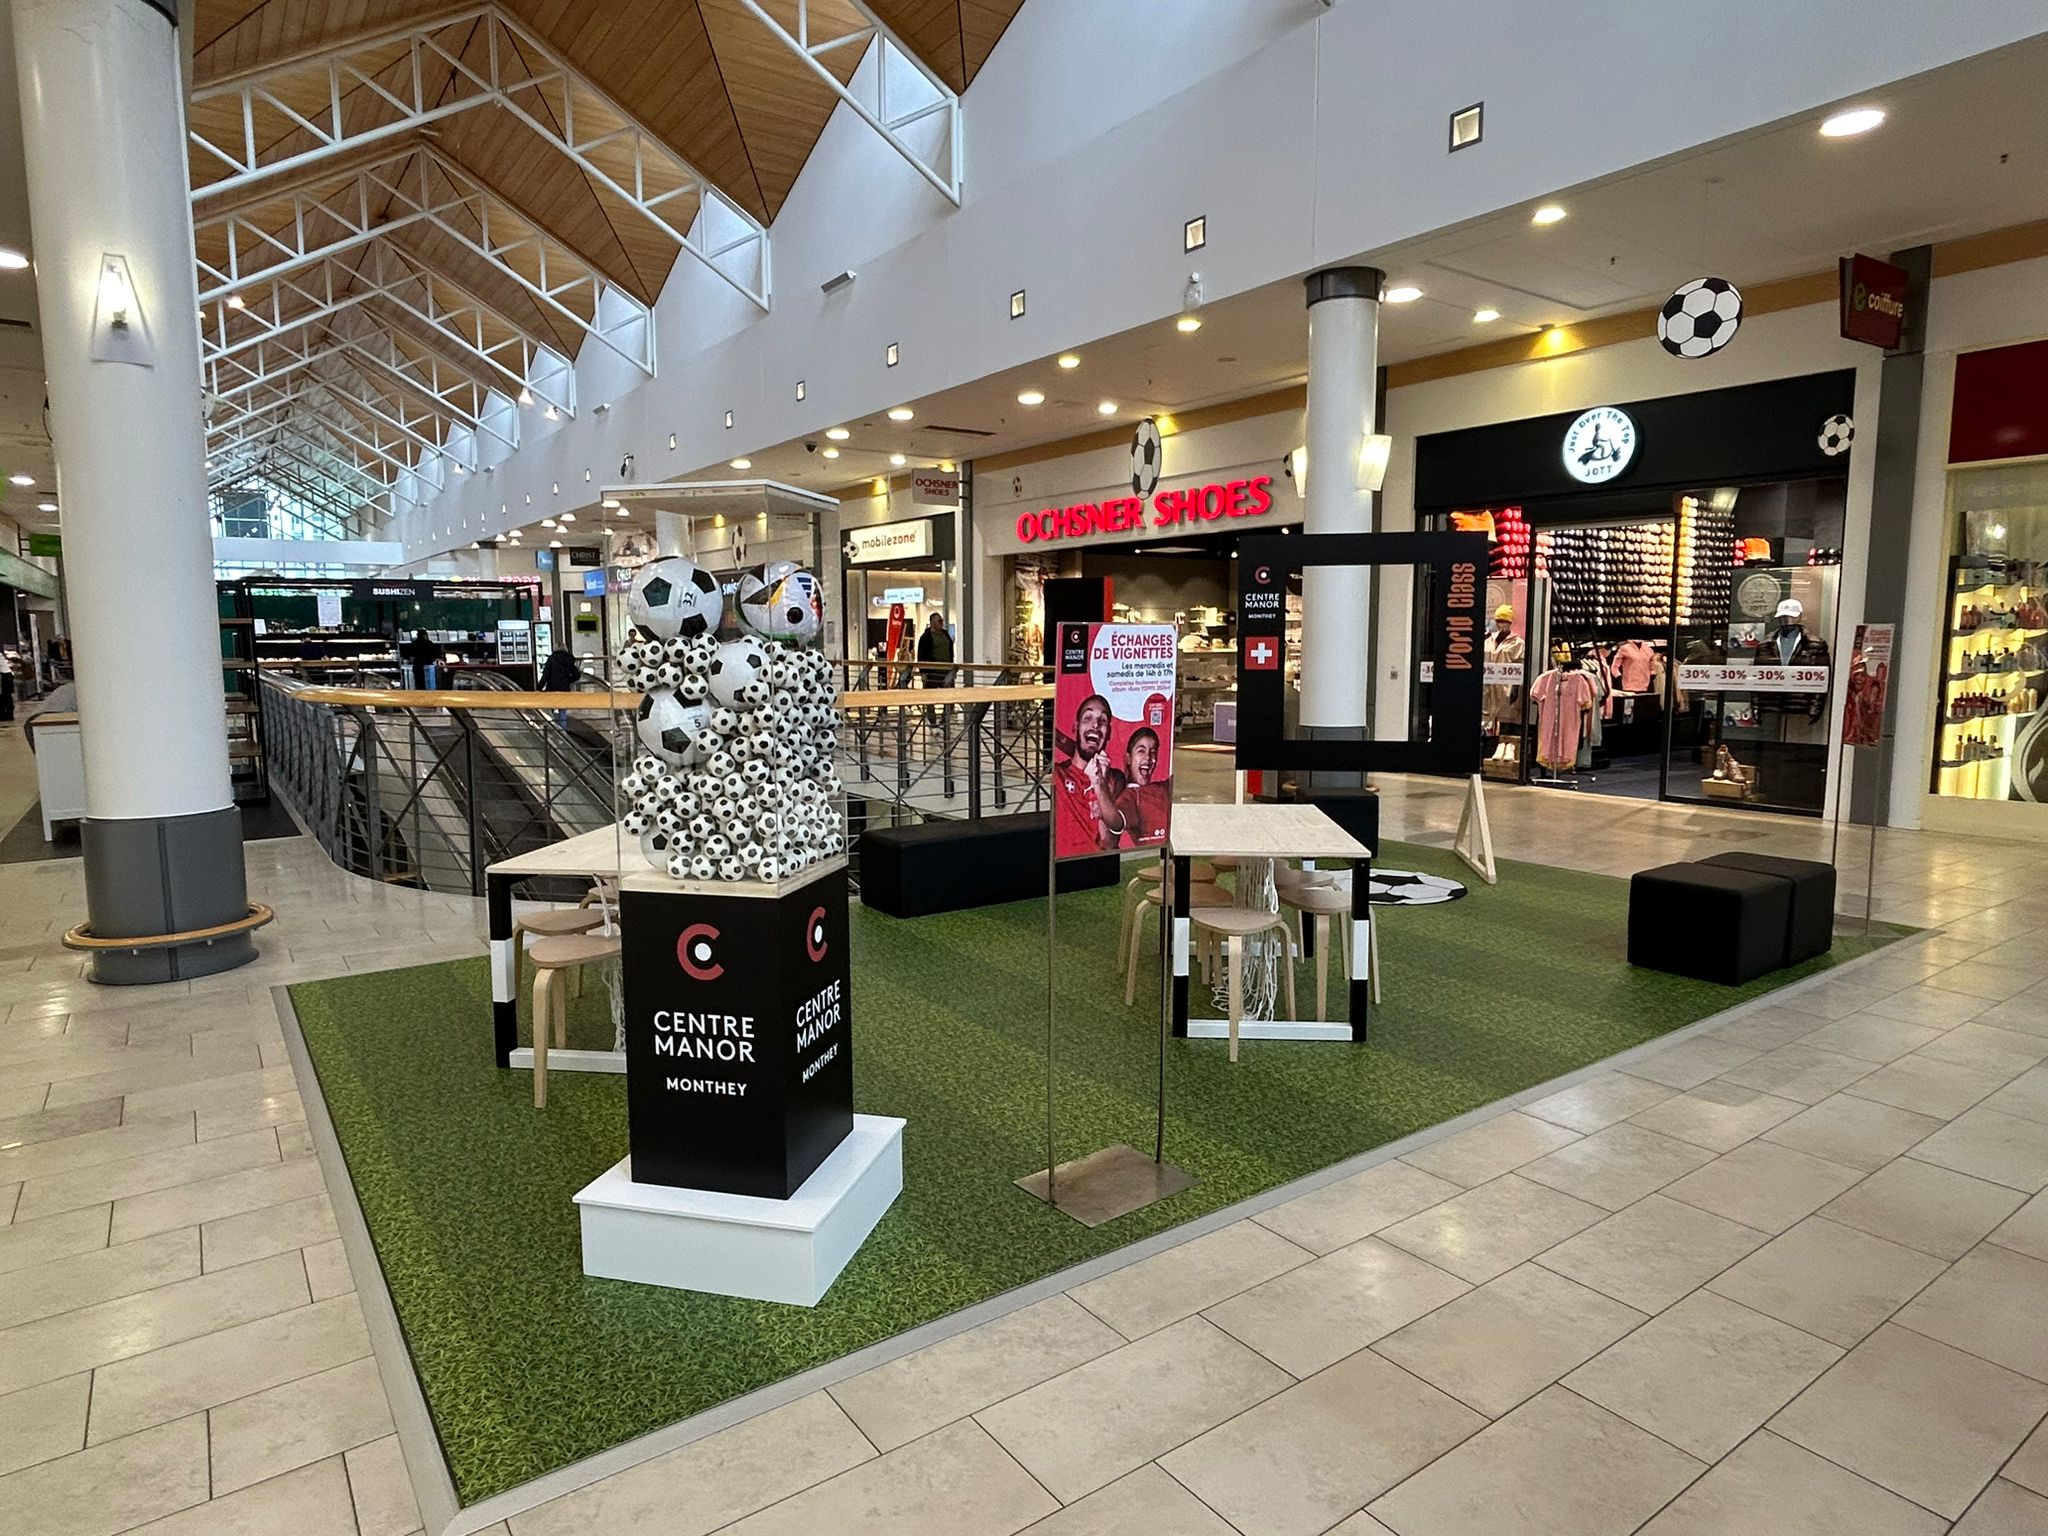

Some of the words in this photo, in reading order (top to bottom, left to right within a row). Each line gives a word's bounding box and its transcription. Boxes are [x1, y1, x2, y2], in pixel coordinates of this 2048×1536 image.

[1868, 292, 1904, 318] coiffure
[1568, 431, 1580, 453] Just
[1578, 412, 1602, 428] Over
[1606, 411, 1623, 424] The
[1621, 425, 1631, 444] Top
[1585, 465, 1613, 477] JOTT
[915, 478, 959, 489] OCHSNER
[924, 487, 950, 497] SHOES
[1015, 497, 1145, 543] OCHSNER
[1153, 475, 1272, 527] SHOES
[861, 532, 917, 549] mobilezone
[372, 587, 416, 596] SUSHIZEN
[1245, 593, 1280, 601] CENTRE
[682, 592, 694, 607] 32
[1111, 631, 1173, 647] ÉCHANGES
[1094, 648, 1109, 660] DE
[1111, 647, 1174, 660] VIGNETTES
[1122, 662, 1133, 670] Les
[1498, 666, 1522, 676] -30%
[1106, 671, 1135, 679] samedis
[1680, 669, 1710, 679] -30%
[1715, 670, 1747, 680] -30%
[1752, 670, 1785, 681] -30%
[1791, 671, 1825, 682] -30%
[796, 979, 841, 1028] CENTRE
[653, 1010, 755, 1039] CENTRE
[796, 1003, 841, 1054] MANOR
[654, 1034, 756, 1063] MANOR
[802, 1043, 838, 1084] MONTHEY
[666, 1077, 747, 1097] MONTHEY
